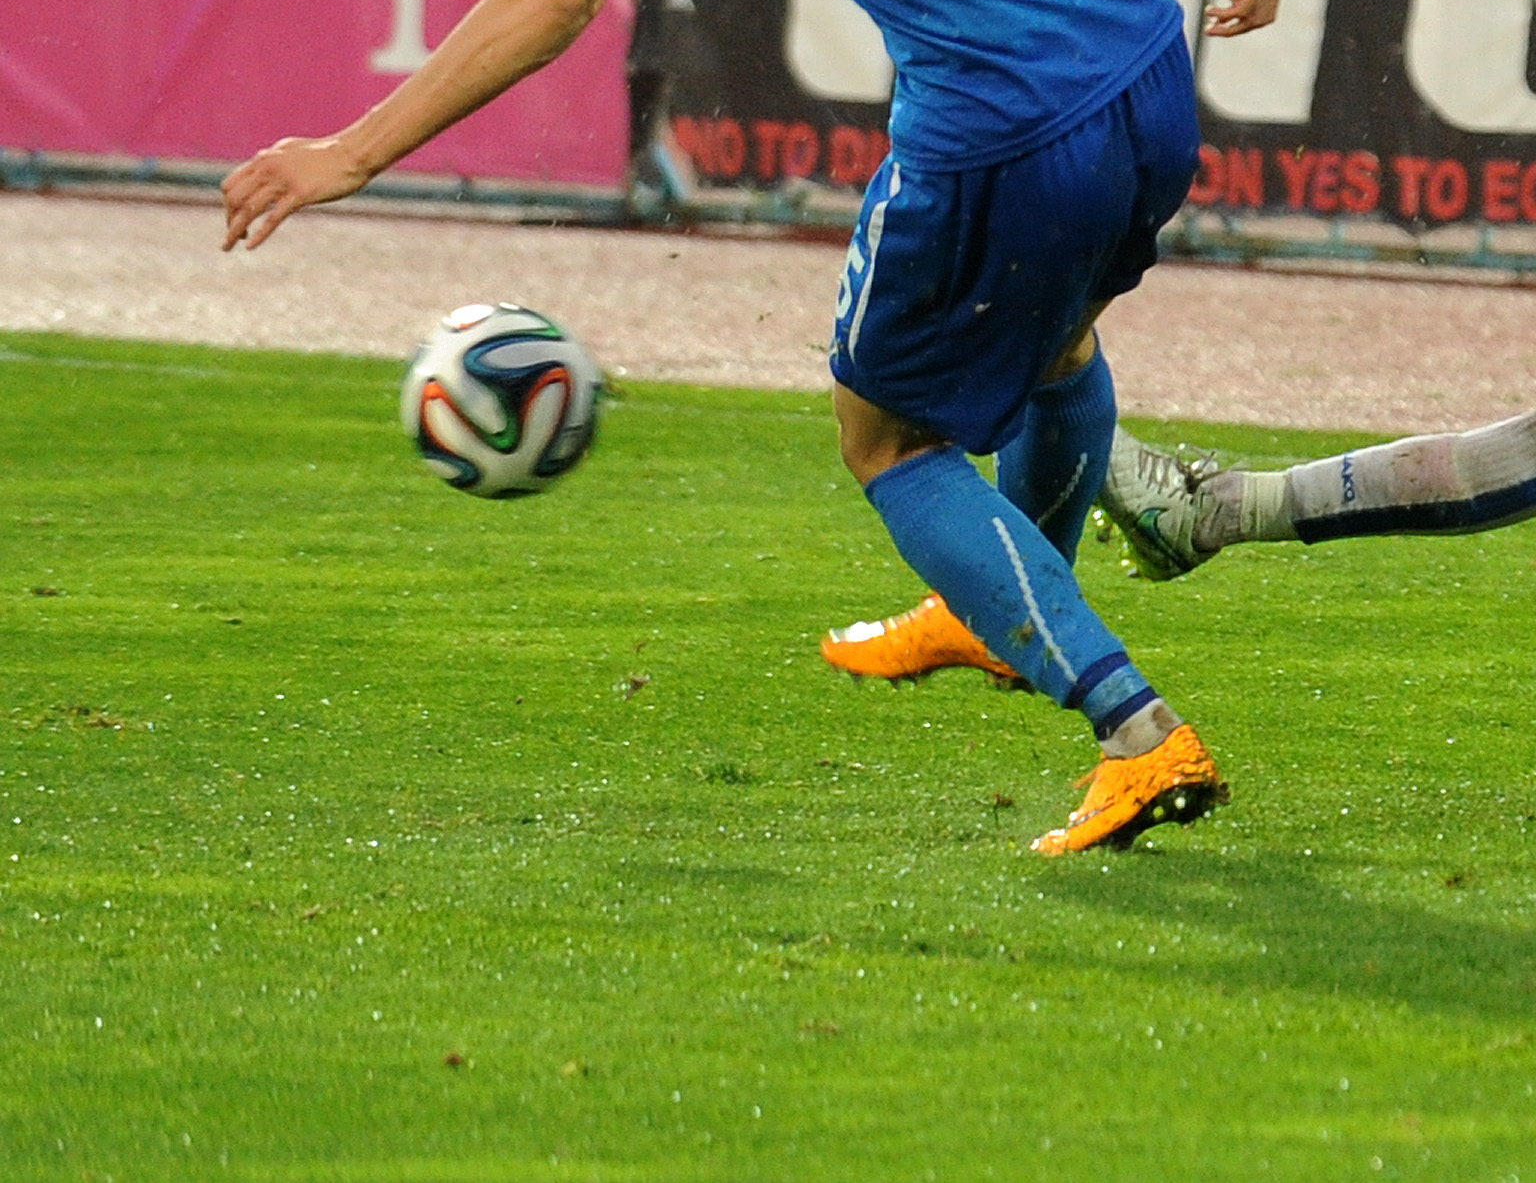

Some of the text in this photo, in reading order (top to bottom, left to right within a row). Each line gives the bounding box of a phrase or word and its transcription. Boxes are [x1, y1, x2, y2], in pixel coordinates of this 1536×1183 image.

[673, 114, 745, 178] NO
[754, 119, 819, 183] TO
[1276, 148, 1382, 213] YES
[1391, 154, 1469, 221] TO
